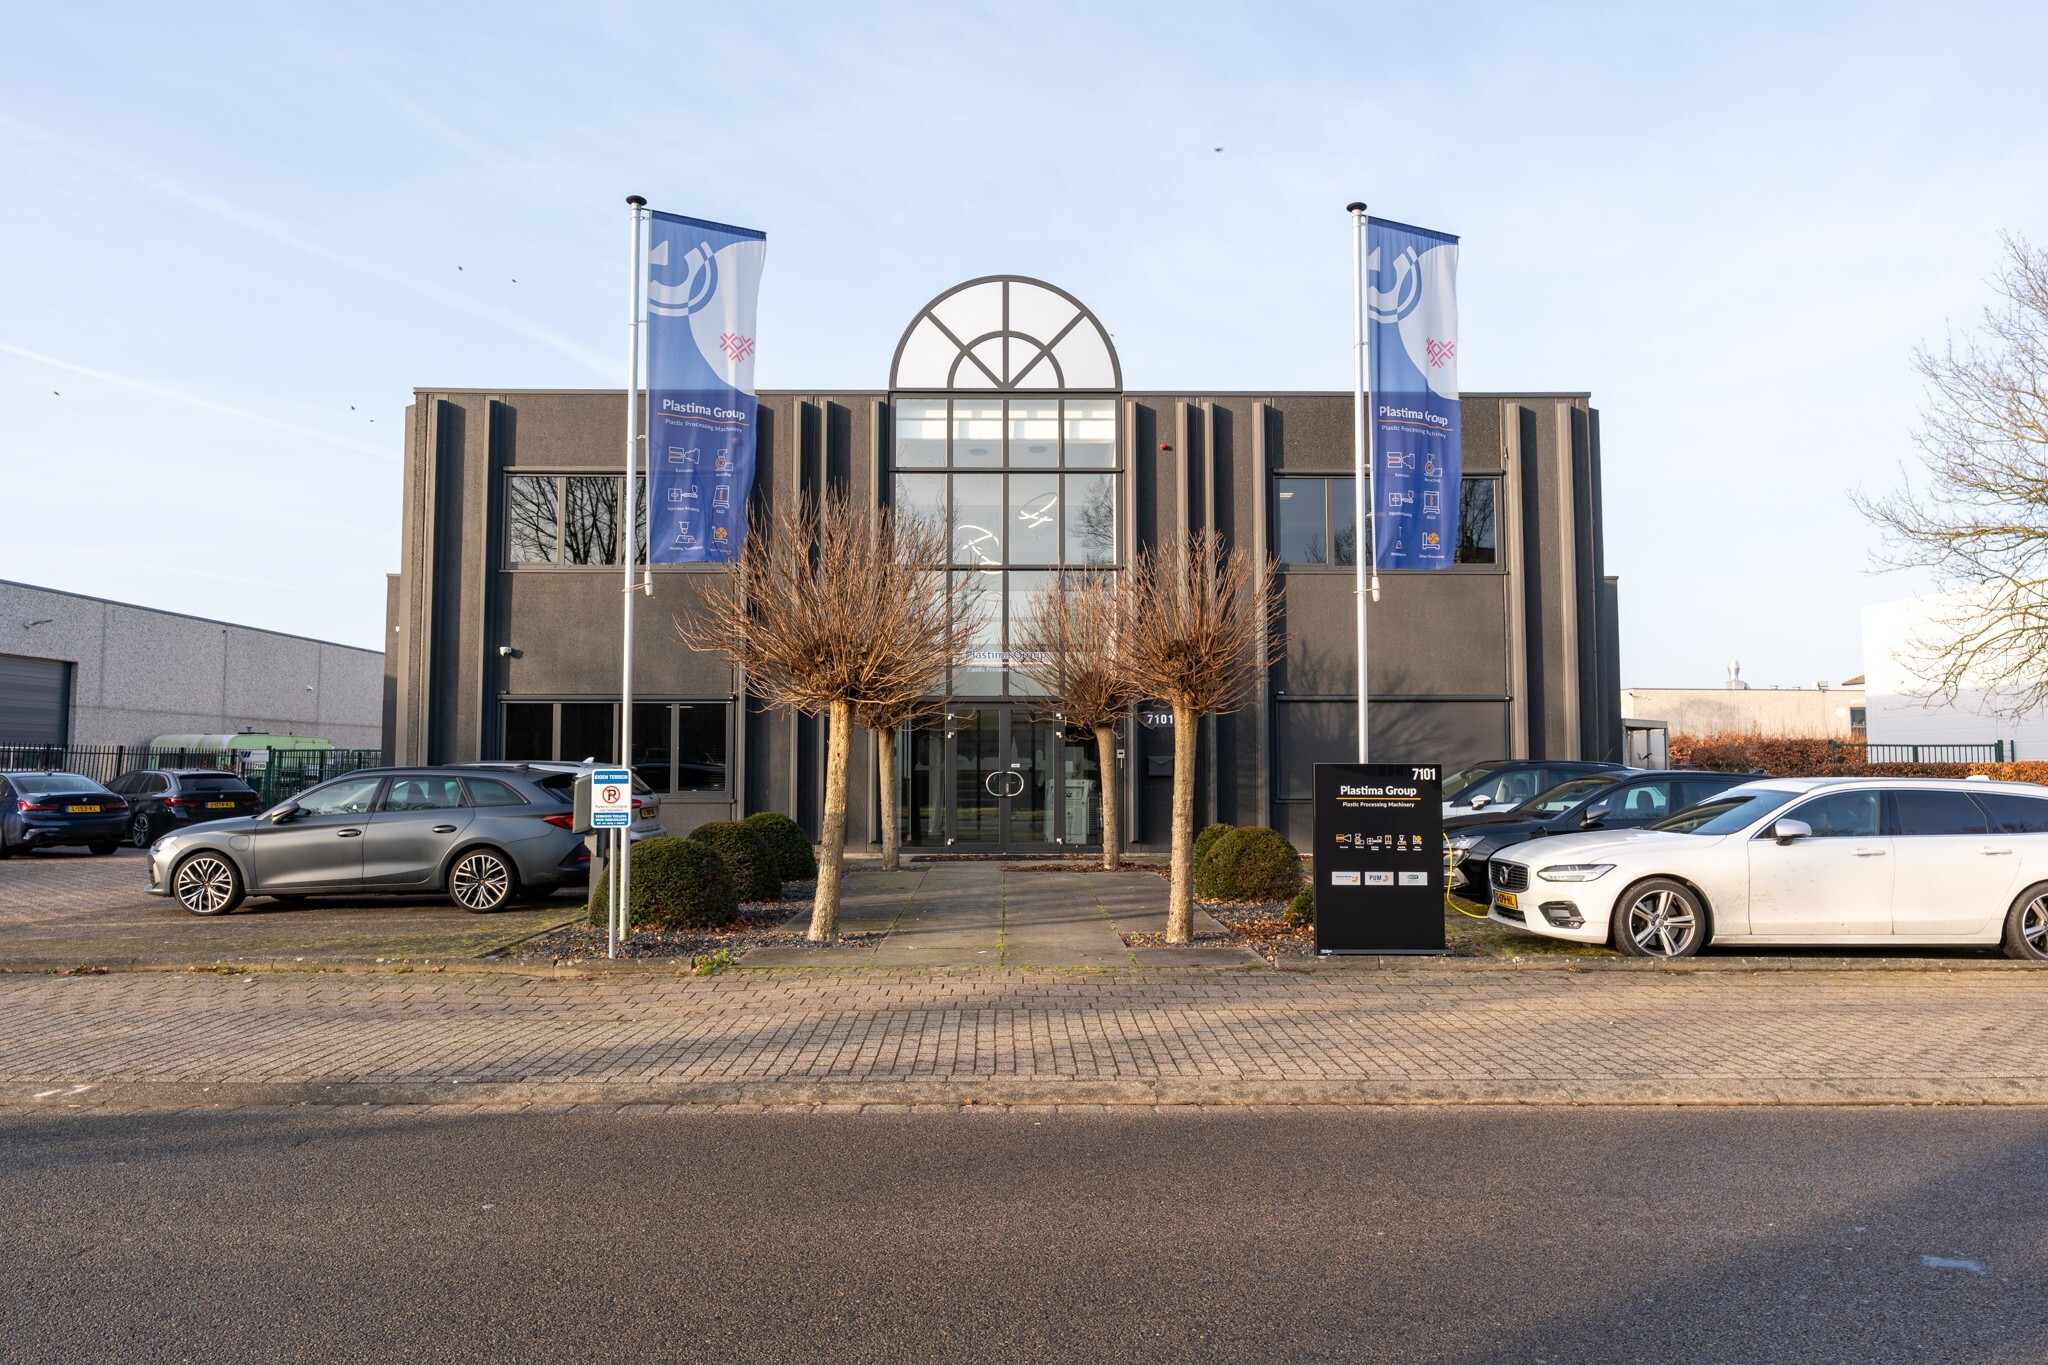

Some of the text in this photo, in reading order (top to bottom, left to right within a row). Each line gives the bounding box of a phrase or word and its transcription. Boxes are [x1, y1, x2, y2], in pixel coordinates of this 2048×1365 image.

[663, 399, 745, 421] Plastima Group
[1379, 406, 1423, 419] Plastima
[665, 418, 684, 427] Plastic
[685, 421, 714, 431] Processing
[1401, 426, 1425, 435] Processing
[965, 650, 1010, 660] Plastima
[1147, 714, 1173, 724] 7101
[1412, 768, 1435, 780] 7101
[1340, 785, 1417, 797] Plastima Group
